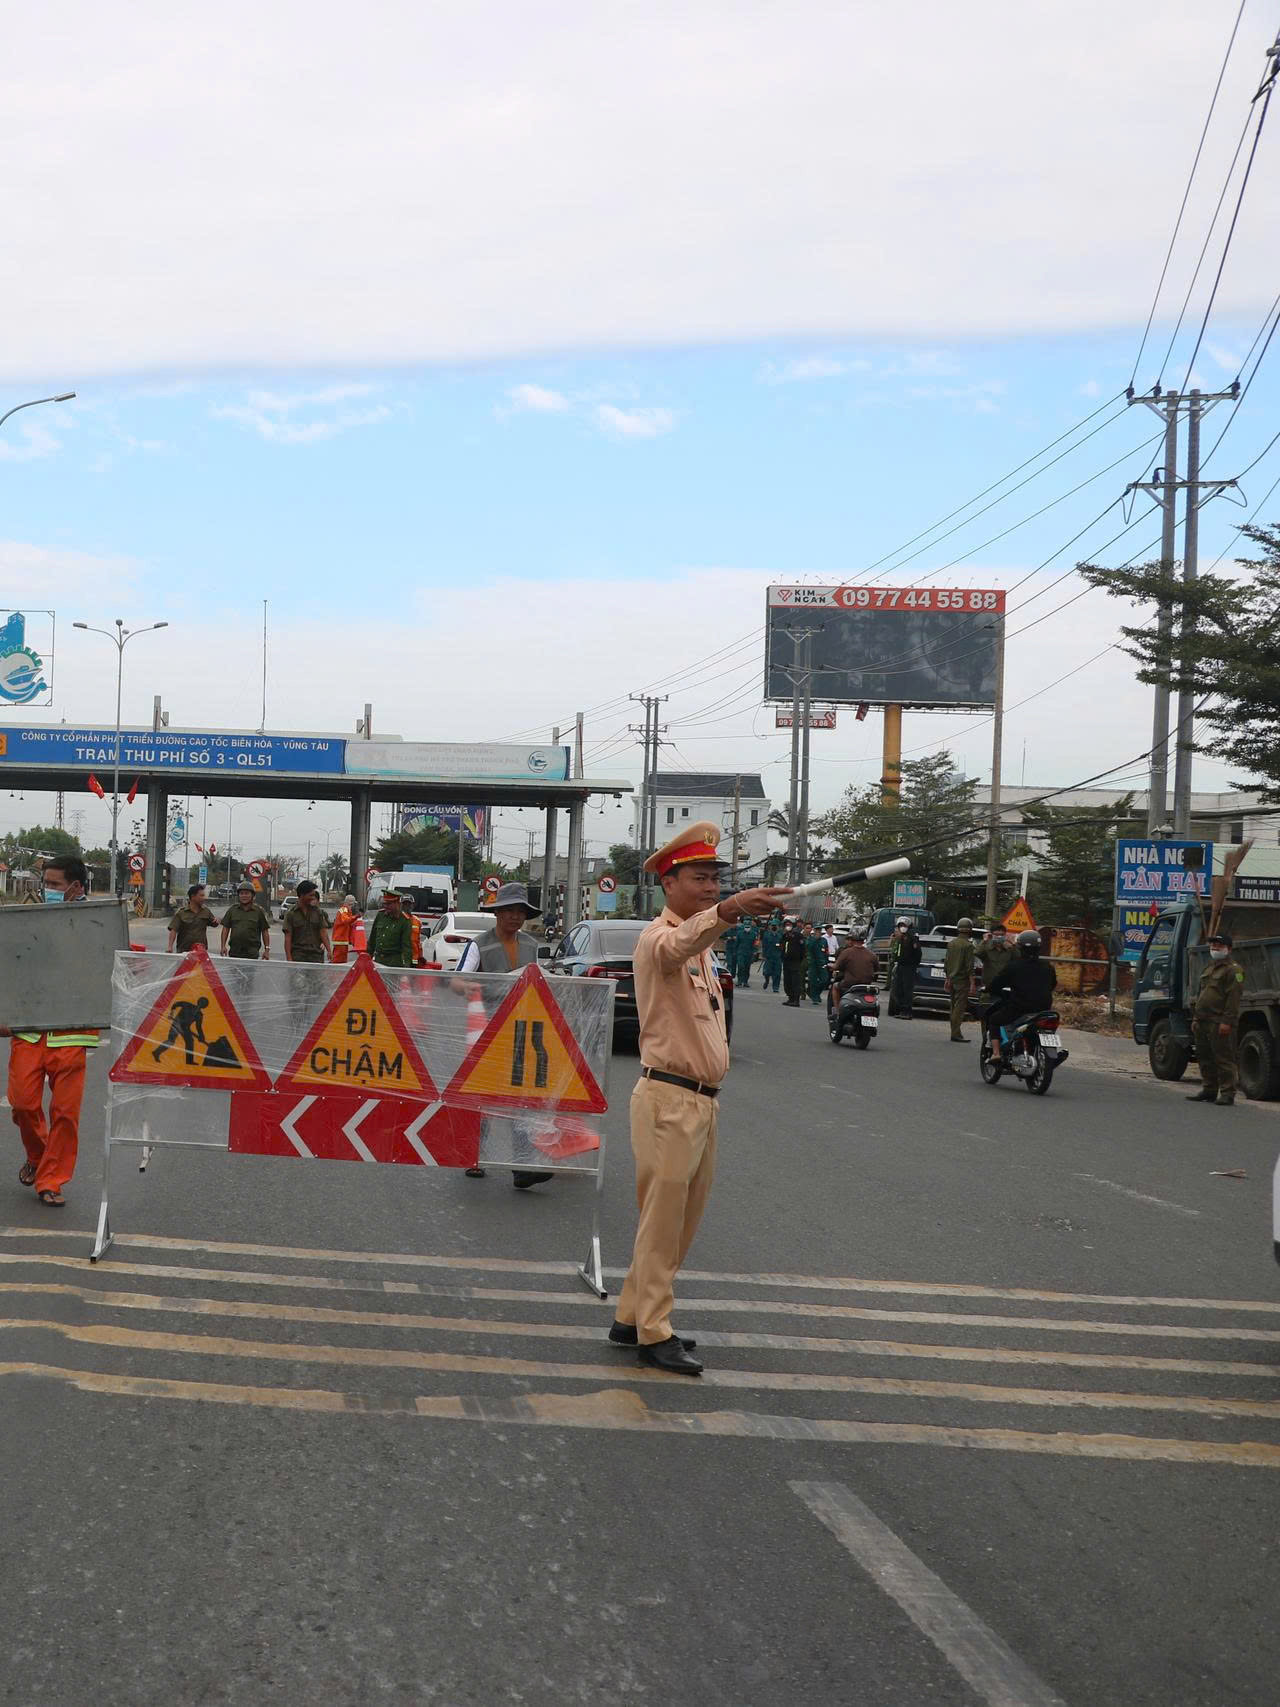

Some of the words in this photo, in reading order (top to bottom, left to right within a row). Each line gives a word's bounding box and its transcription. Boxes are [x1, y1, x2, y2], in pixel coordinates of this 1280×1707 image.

[842, 589, 870, 606] 09
[874, 590, 902, 607] 77
[904, 591, 931, 608] 44
[936, 592, 964, 608] 55
[969, 592, 997, 609] 88
[22, 731, 46, 741] CÔNG
[211, 736, 228, 747] TỐC
[76, 748, 118, 763] TRẠM
[125, 749, 155, 762] THU
[160, 749, 184, 763] PHÍ
[189, 748, 210, 764] SỐ
[217, 754, 224, 764] 3
[237, 754, 272, 766] QL51
[1124, 844, 1160, 864] NHÀ
[1120, 866, 1163, 891] TÂN
[346, 1008, 377, 1036] ĐI
[310, 1043, 403, 1084] CHẬM
